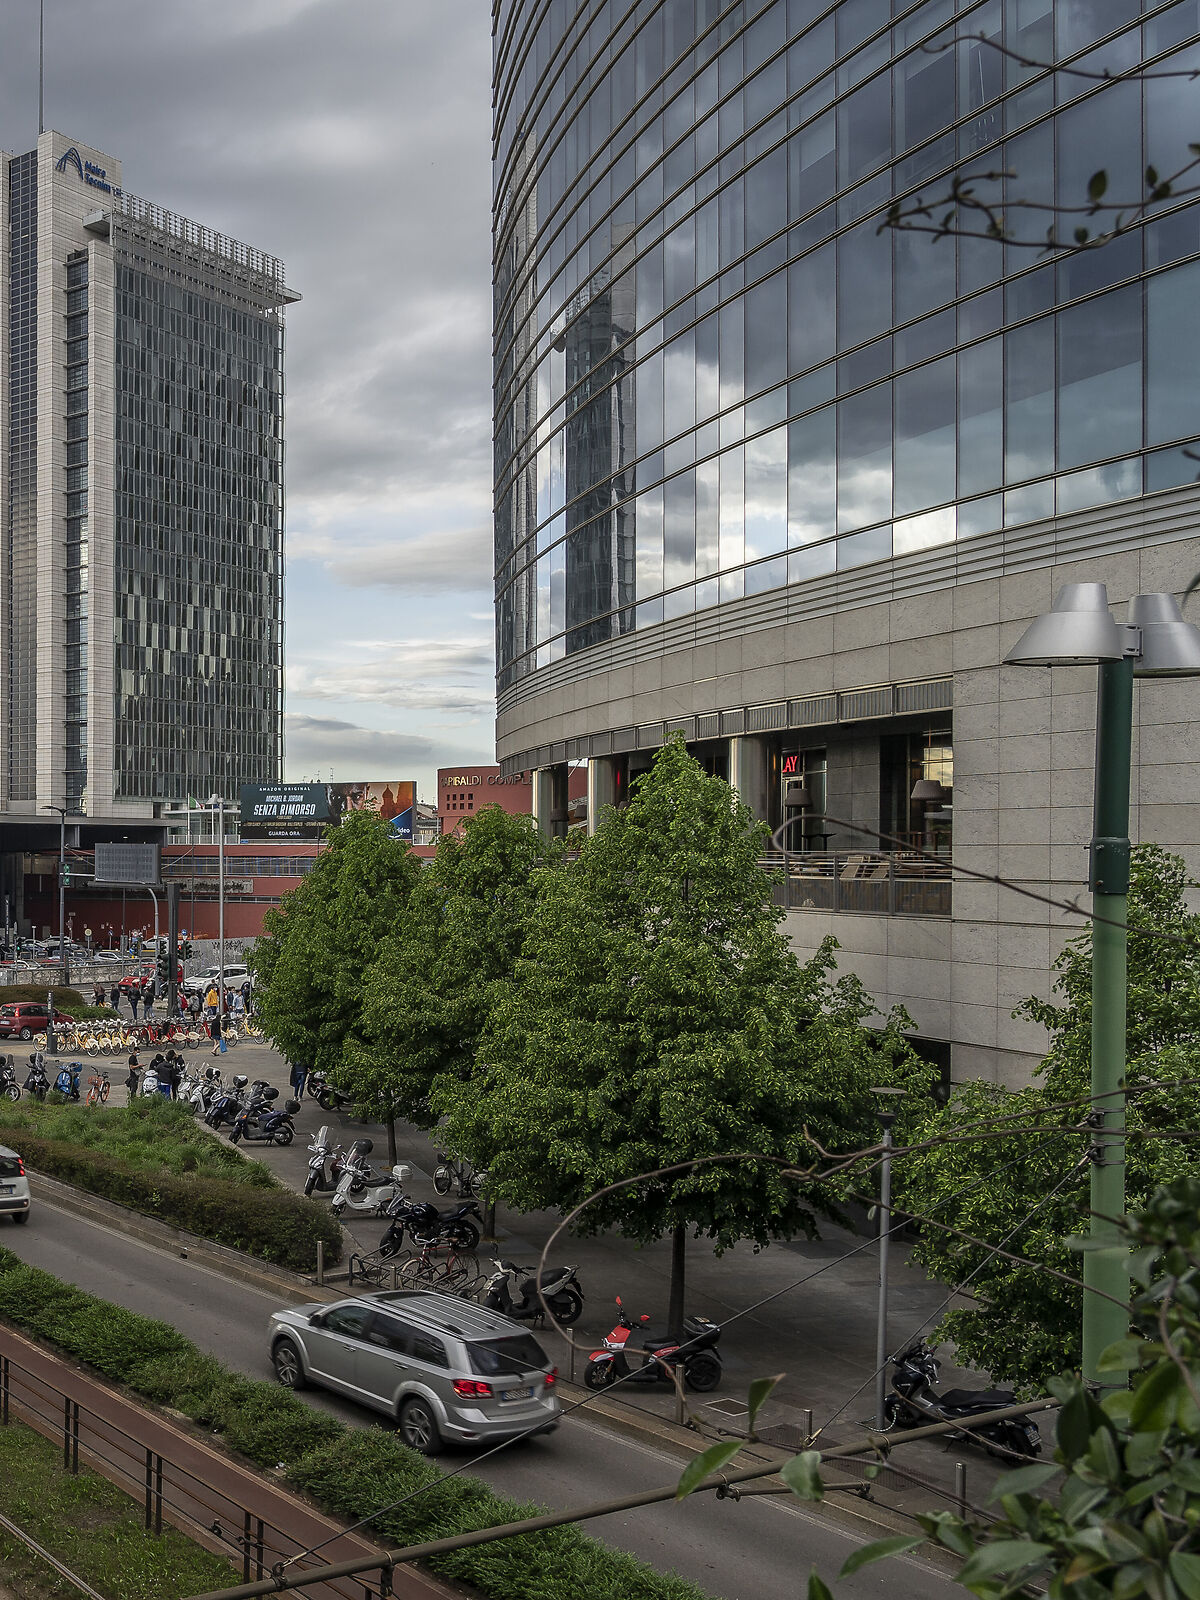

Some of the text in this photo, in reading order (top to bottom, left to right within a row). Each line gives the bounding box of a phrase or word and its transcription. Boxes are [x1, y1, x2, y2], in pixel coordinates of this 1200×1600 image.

[782, 755, 798, 773] AY
[487, 774, 533, 786] COMPLE
[253, 803, 316, 816] SENZA RIMORSO
